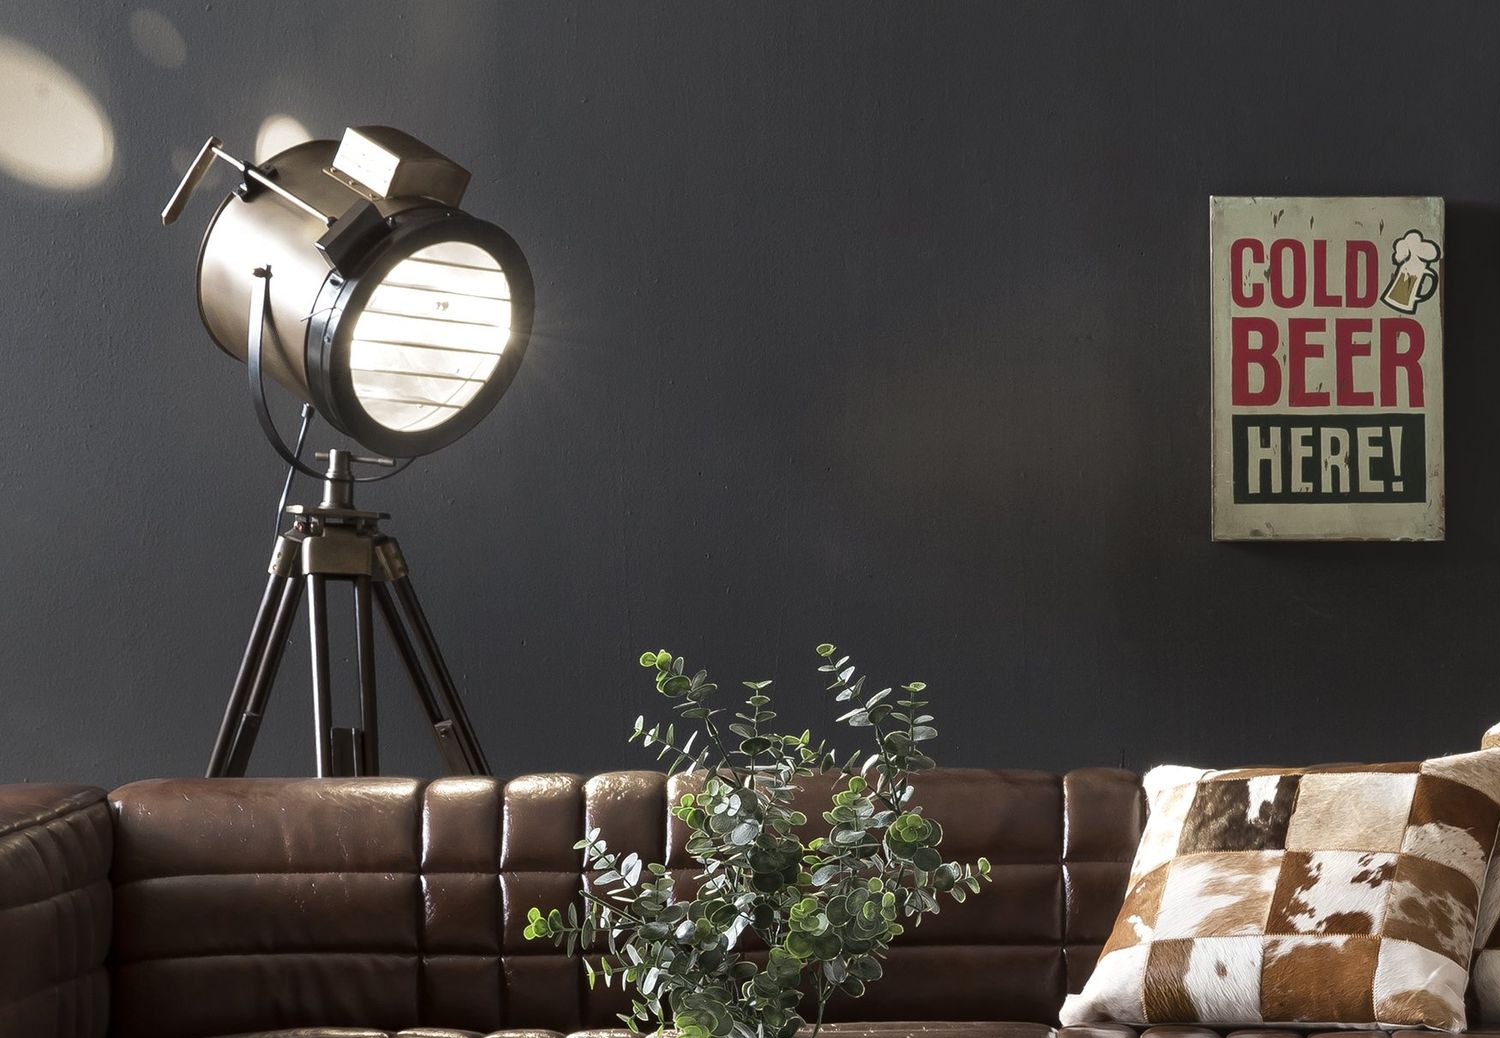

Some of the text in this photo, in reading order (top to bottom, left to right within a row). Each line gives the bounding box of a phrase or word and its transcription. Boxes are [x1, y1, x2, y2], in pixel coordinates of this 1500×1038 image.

[1230, 238, 1380, 309] COLD
[1231, 316, 1426, 408] BEER
[1247, 425, 1405, 494] HERE!
